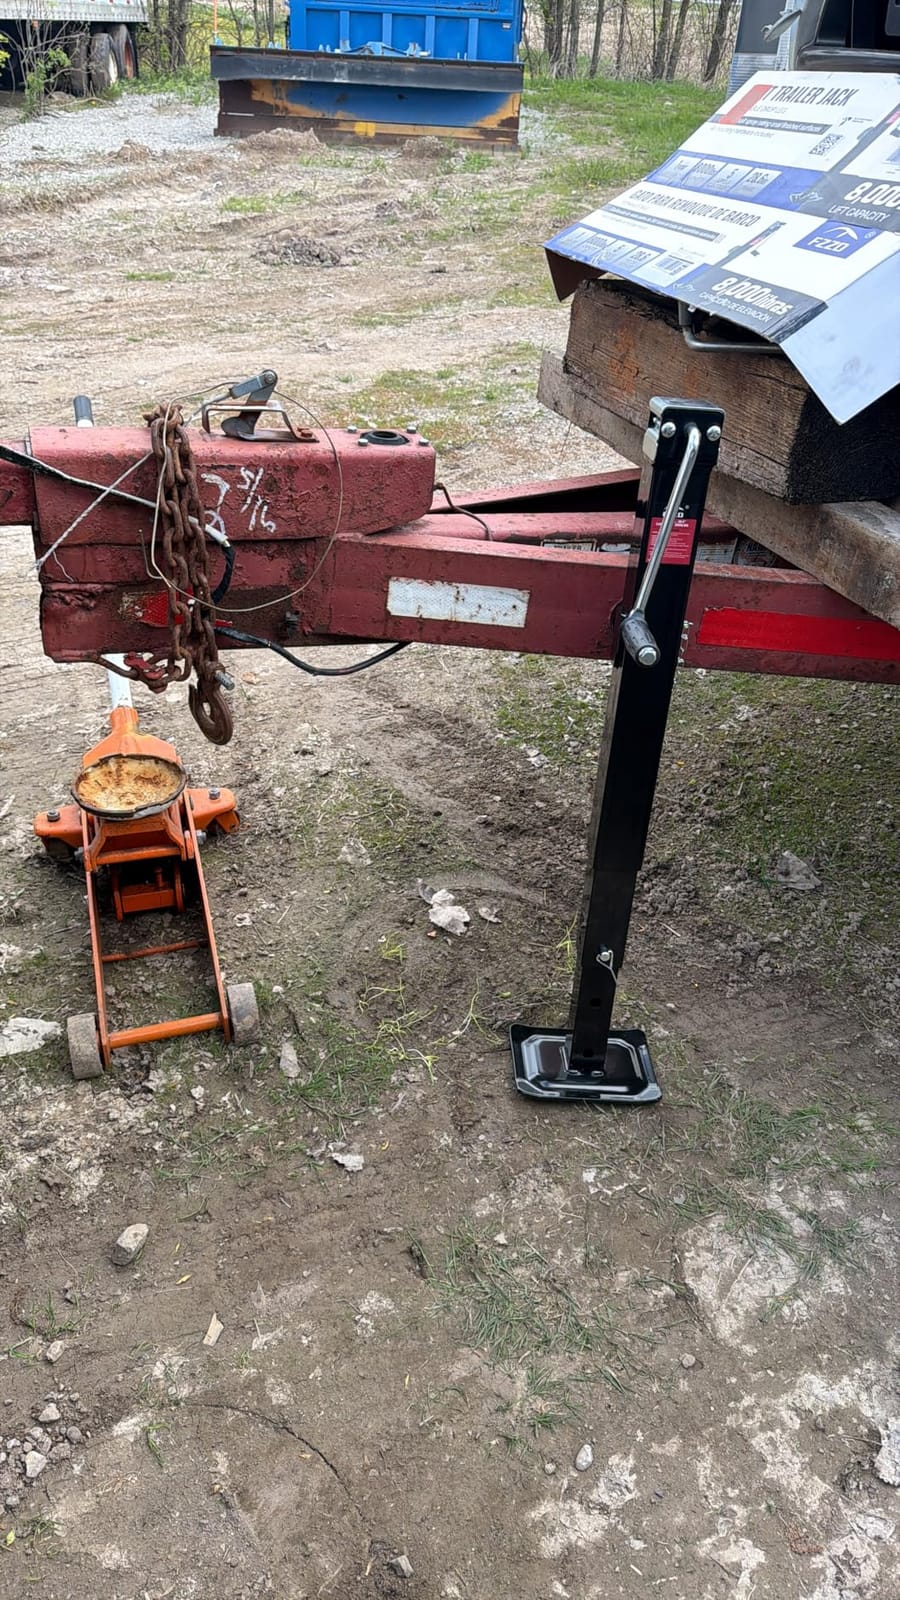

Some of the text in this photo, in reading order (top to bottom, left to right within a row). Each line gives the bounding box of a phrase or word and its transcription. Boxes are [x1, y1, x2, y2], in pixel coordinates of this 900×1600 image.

[771, 86, 822, 105] TRAILER
[816, 88, 859, 107] JACK
[843, 182, 900, 210] 8,000
[647, 193, 675, 207] PARA
[667, 198, 718, 217] REMOLQUE
[709, 207, 731, 220] DE
[721, 210, 761, 227] BARCO
[828, 204, 891, 222] LIFT CAPACITY
